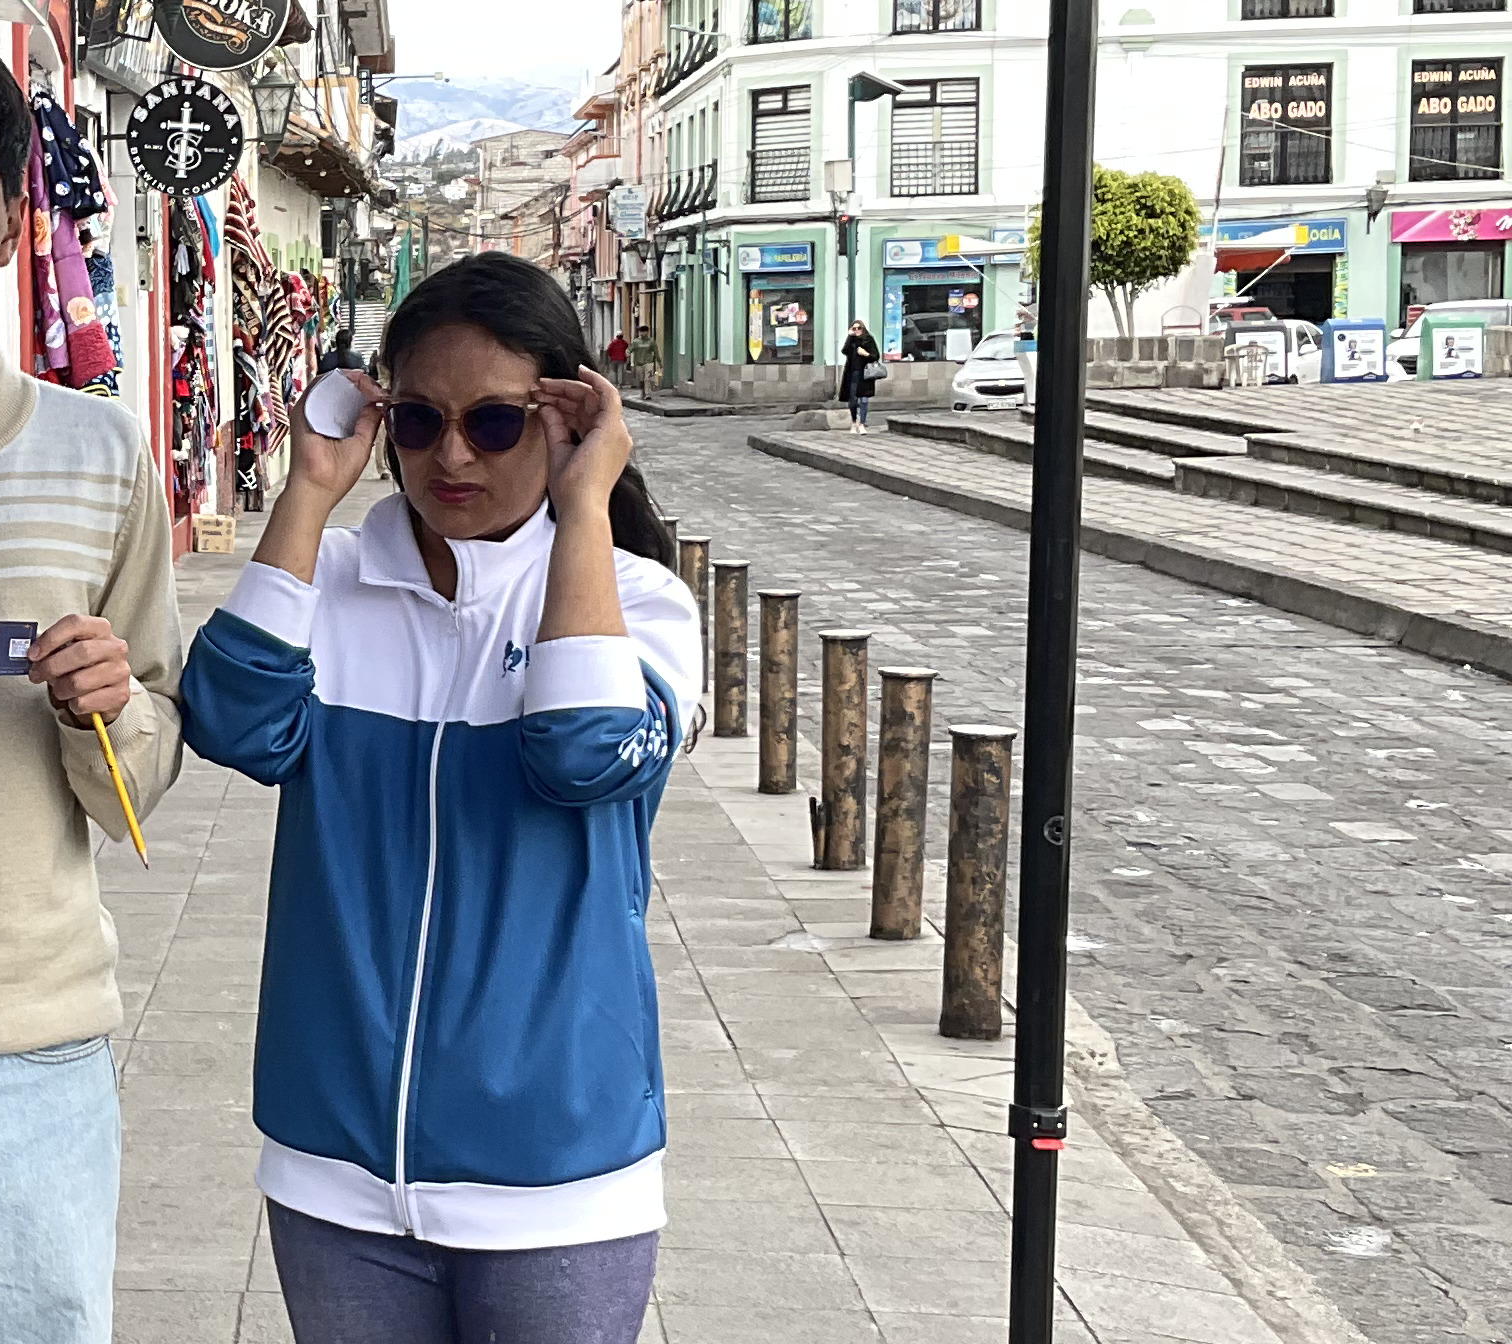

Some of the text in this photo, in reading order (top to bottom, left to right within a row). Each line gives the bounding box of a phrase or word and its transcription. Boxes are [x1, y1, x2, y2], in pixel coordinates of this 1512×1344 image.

[1244, 73, 1326, 88] EDWIN ACUÑA
[1414, 67, 1496, 83] EDWIN ACUÑA
[133, 79, 240, 130] SANTANA
[130, 146, 236, 195] BREWING COMPANY
